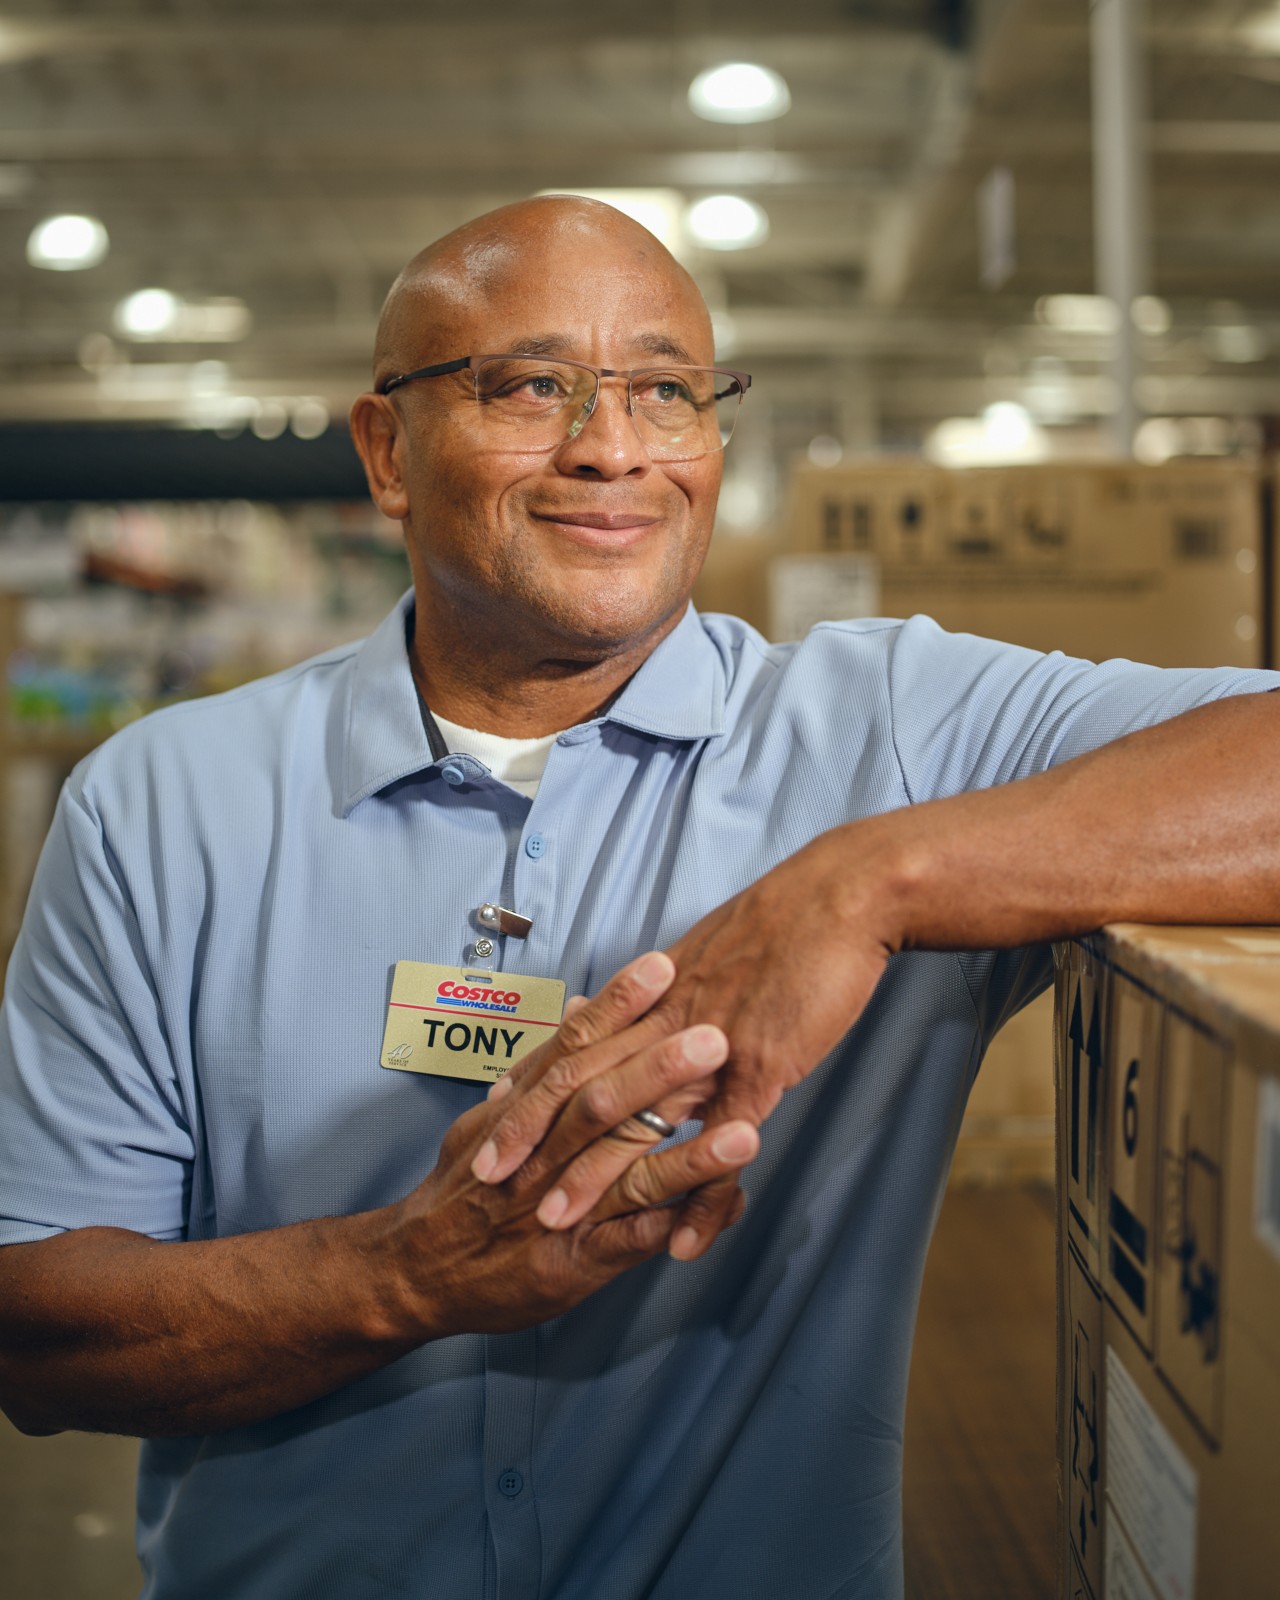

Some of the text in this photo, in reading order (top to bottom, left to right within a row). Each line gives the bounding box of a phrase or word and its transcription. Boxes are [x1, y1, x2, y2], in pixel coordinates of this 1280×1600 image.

[437, 981, 521, 1005] COSTCO
[461, 1000, 517, 1013] WHOLESALE
[423, 1019, 525, 1058] TONY
[387, 1043, 414, 1060] 40
[483, 1064, 510, 1073] EMPLOY
[1123, 1058, 1139, 1158] 6
